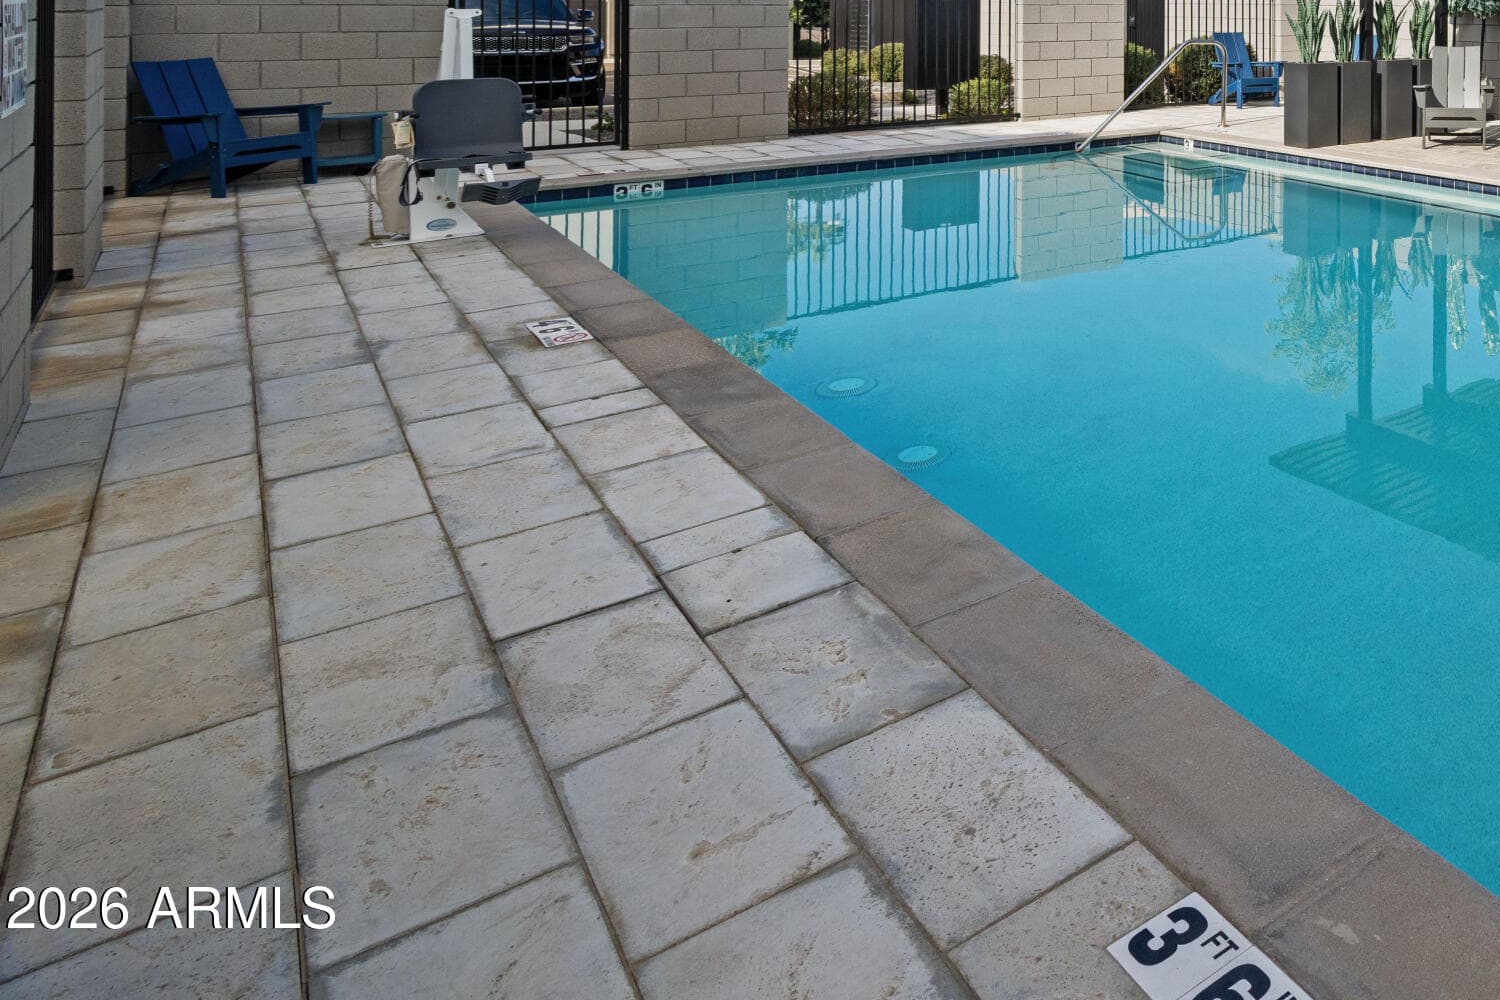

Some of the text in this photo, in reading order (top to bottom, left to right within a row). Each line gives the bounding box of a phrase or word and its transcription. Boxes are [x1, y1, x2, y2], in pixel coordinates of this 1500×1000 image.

[1128, 906, 1271, 1000] 3 FT 6
